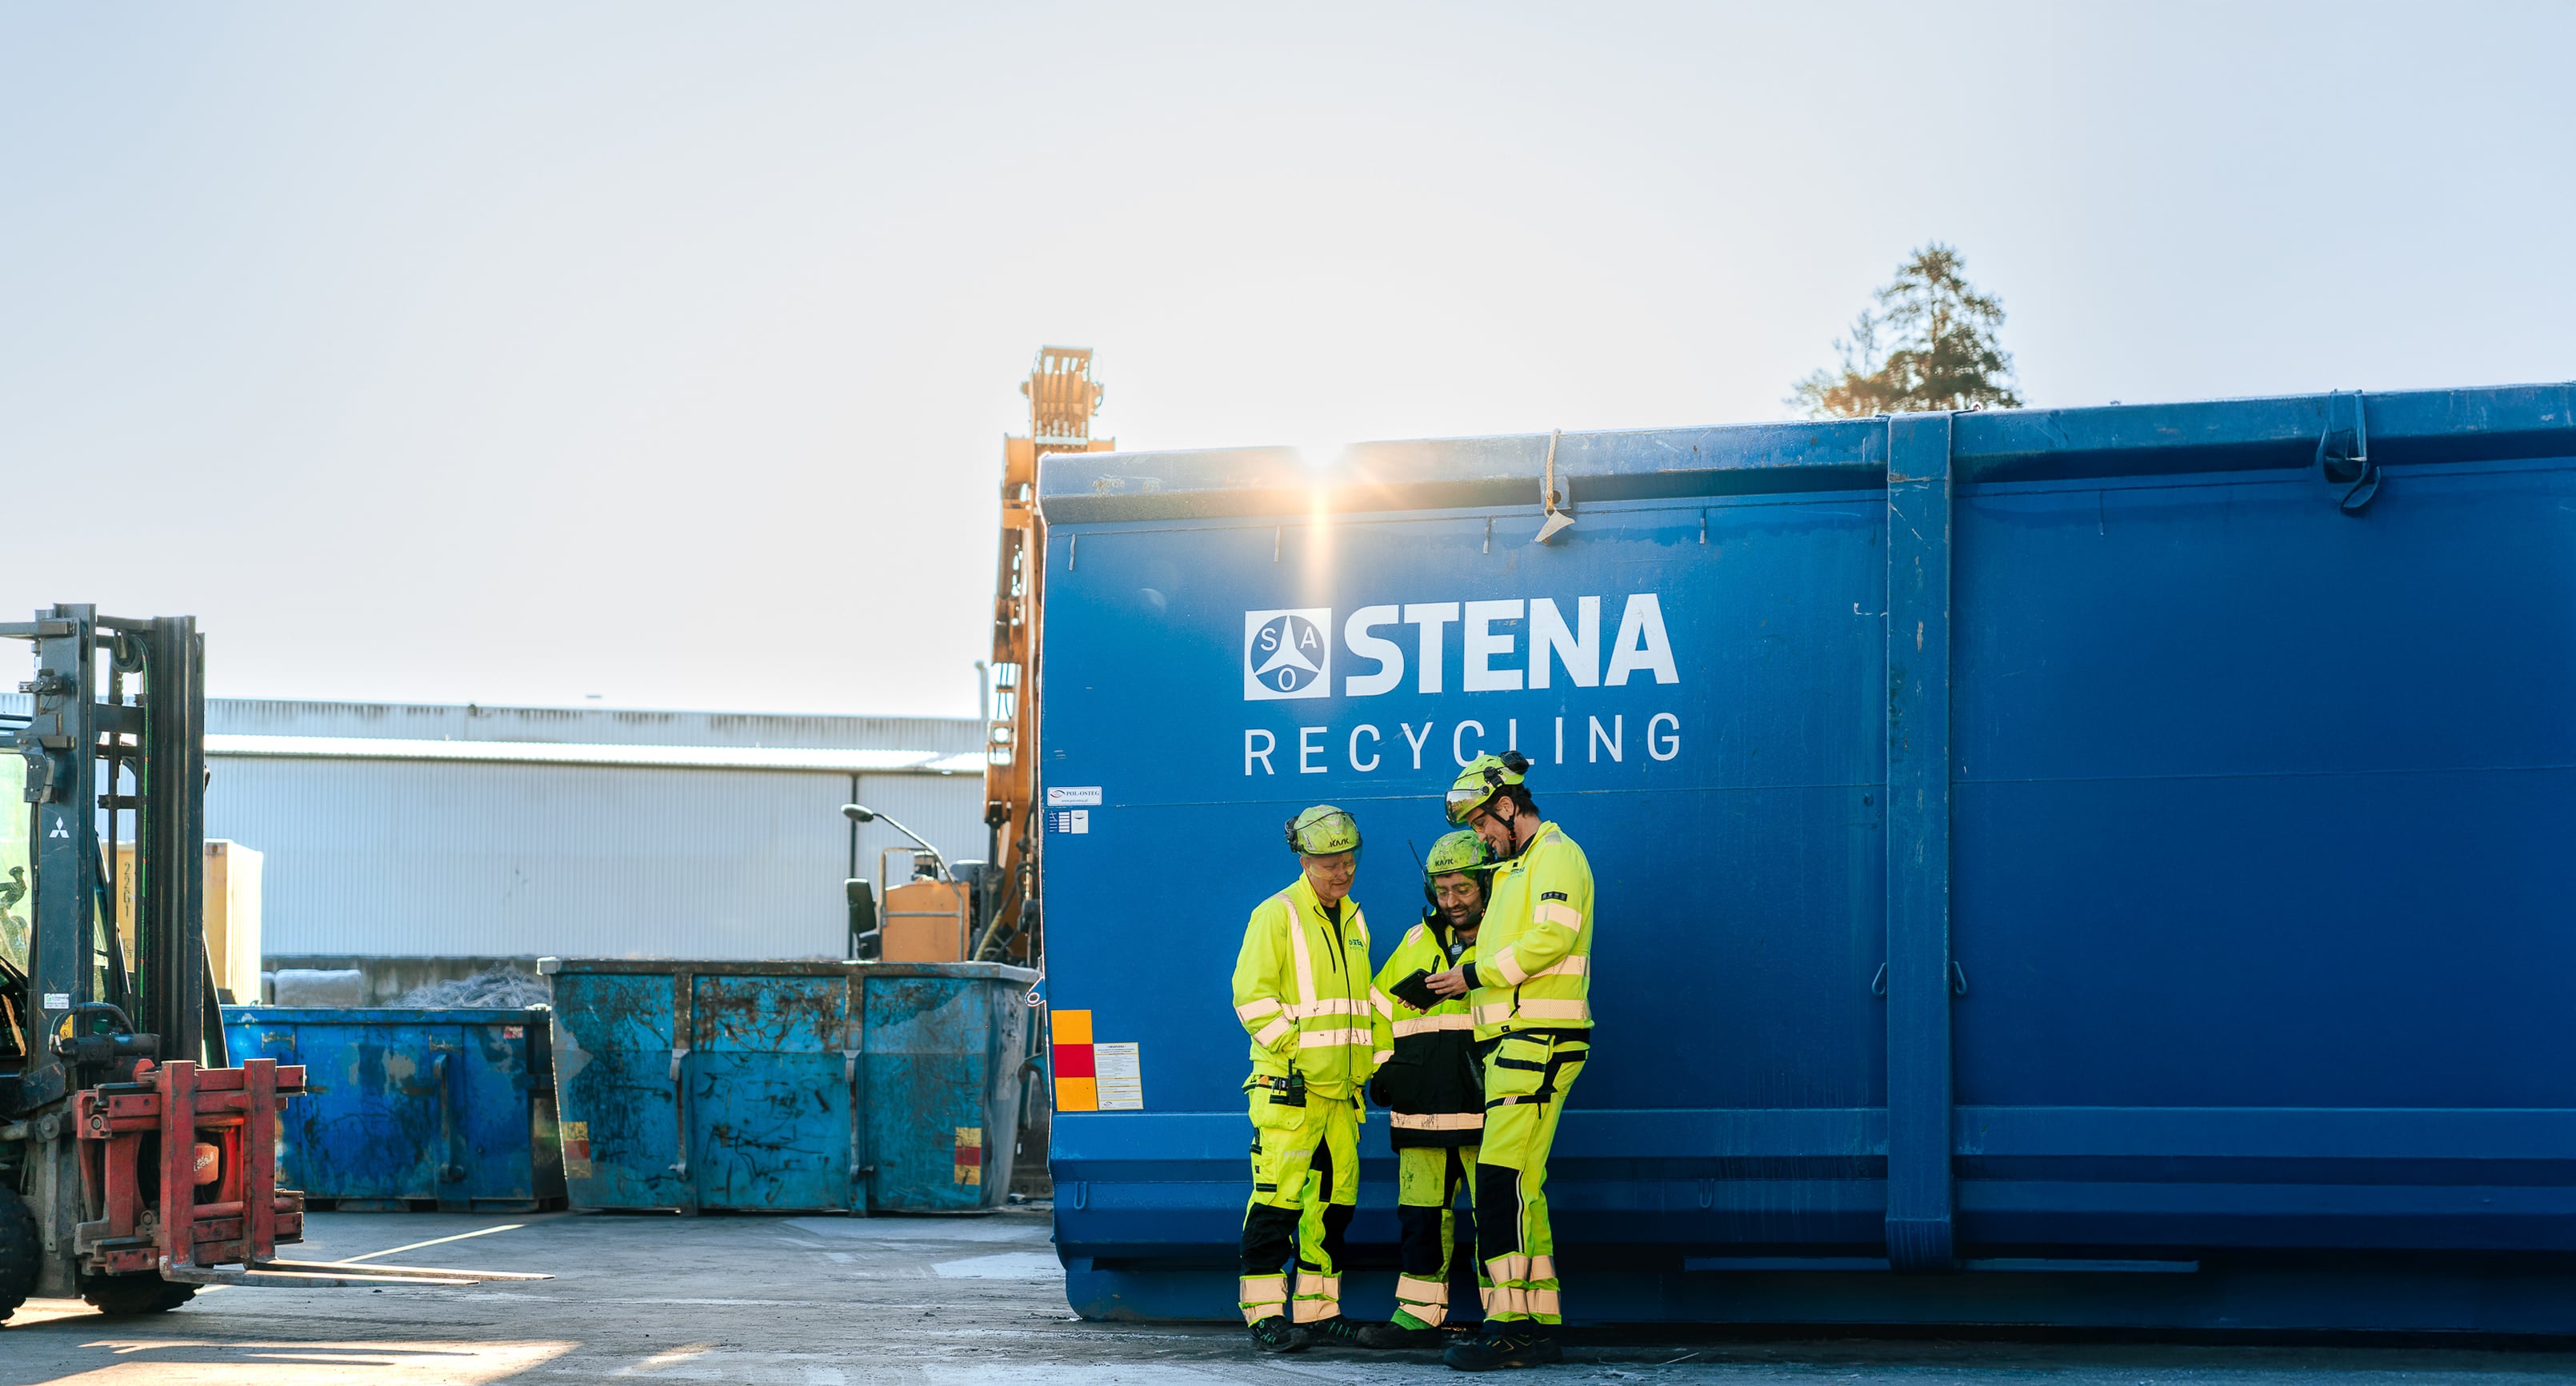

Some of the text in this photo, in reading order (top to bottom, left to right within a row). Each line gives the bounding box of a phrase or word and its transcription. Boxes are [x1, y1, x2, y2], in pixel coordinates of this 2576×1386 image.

[1344, 593, 1680, 697] STENA
[1245, 713, 1680, 776] RECYCLING
[1330, 837, 1350, 848] KASK
